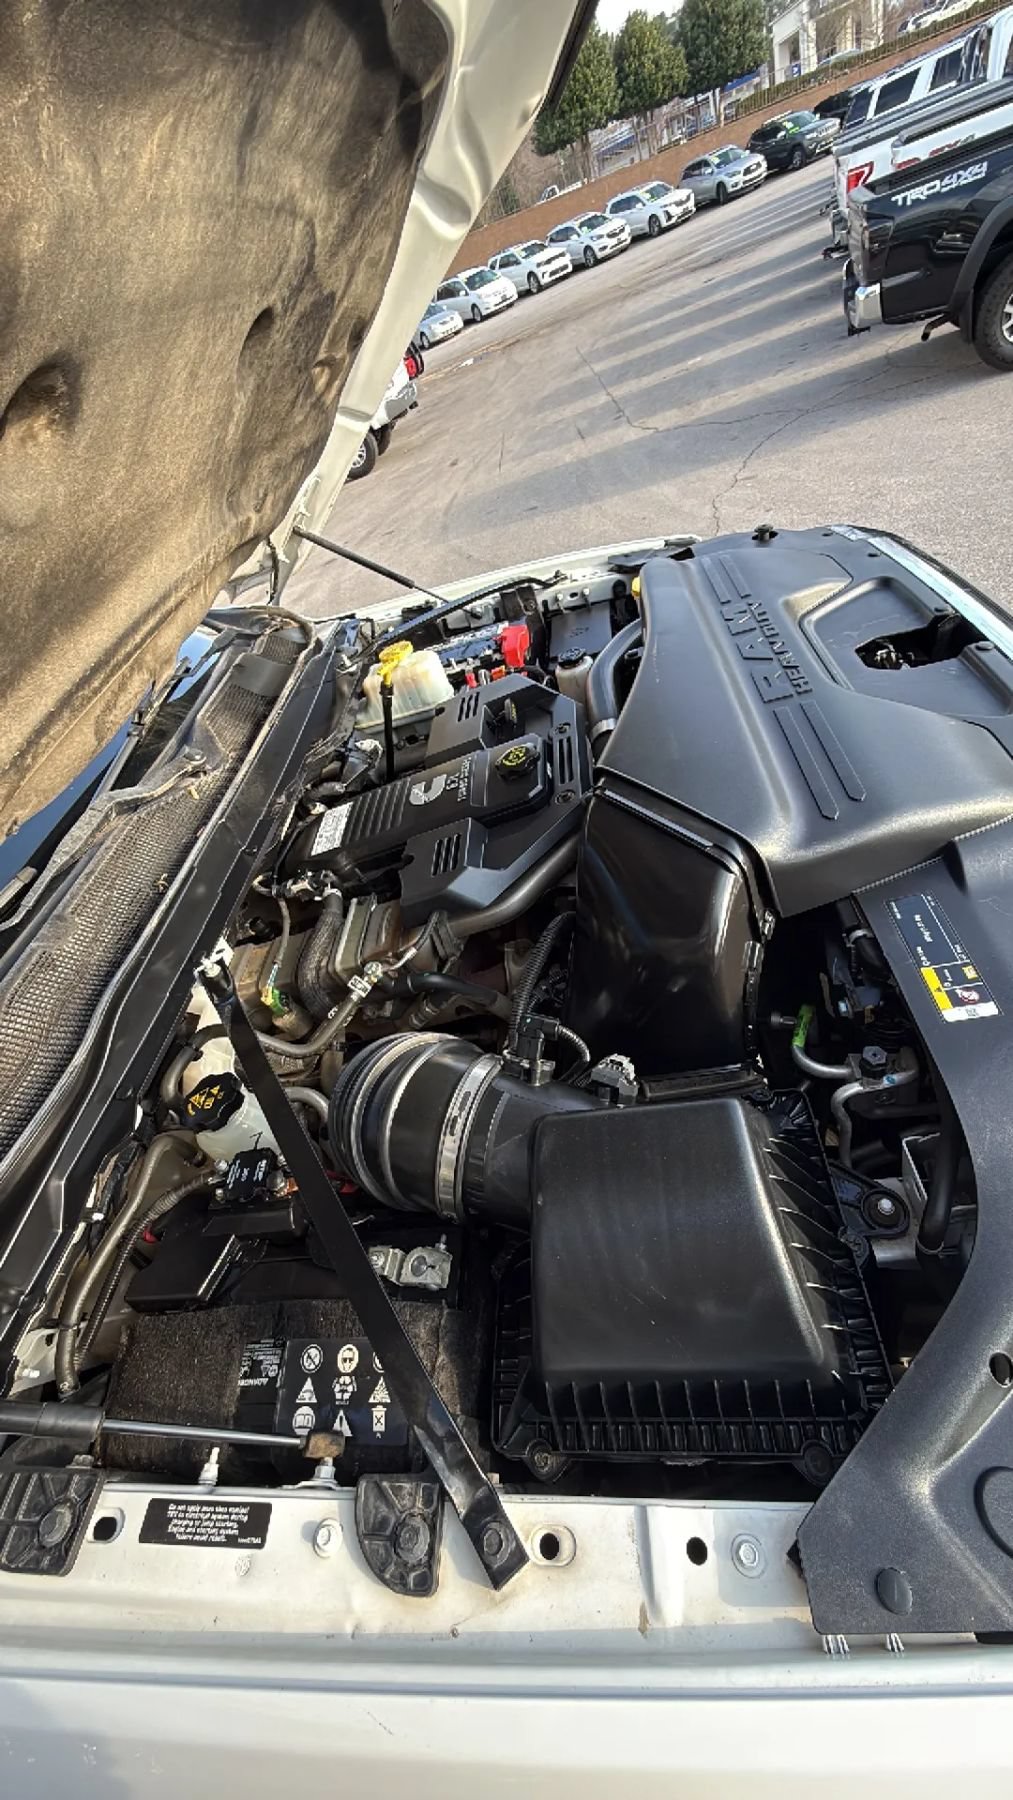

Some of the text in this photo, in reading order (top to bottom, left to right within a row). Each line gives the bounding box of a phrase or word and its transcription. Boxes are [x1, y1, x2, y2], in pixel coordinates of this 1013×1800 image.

[891, 180, 940, 206] TRD
[720, 603, 793, 703] RAM
[747, 601, 812, 695] HEAVY DUTY
